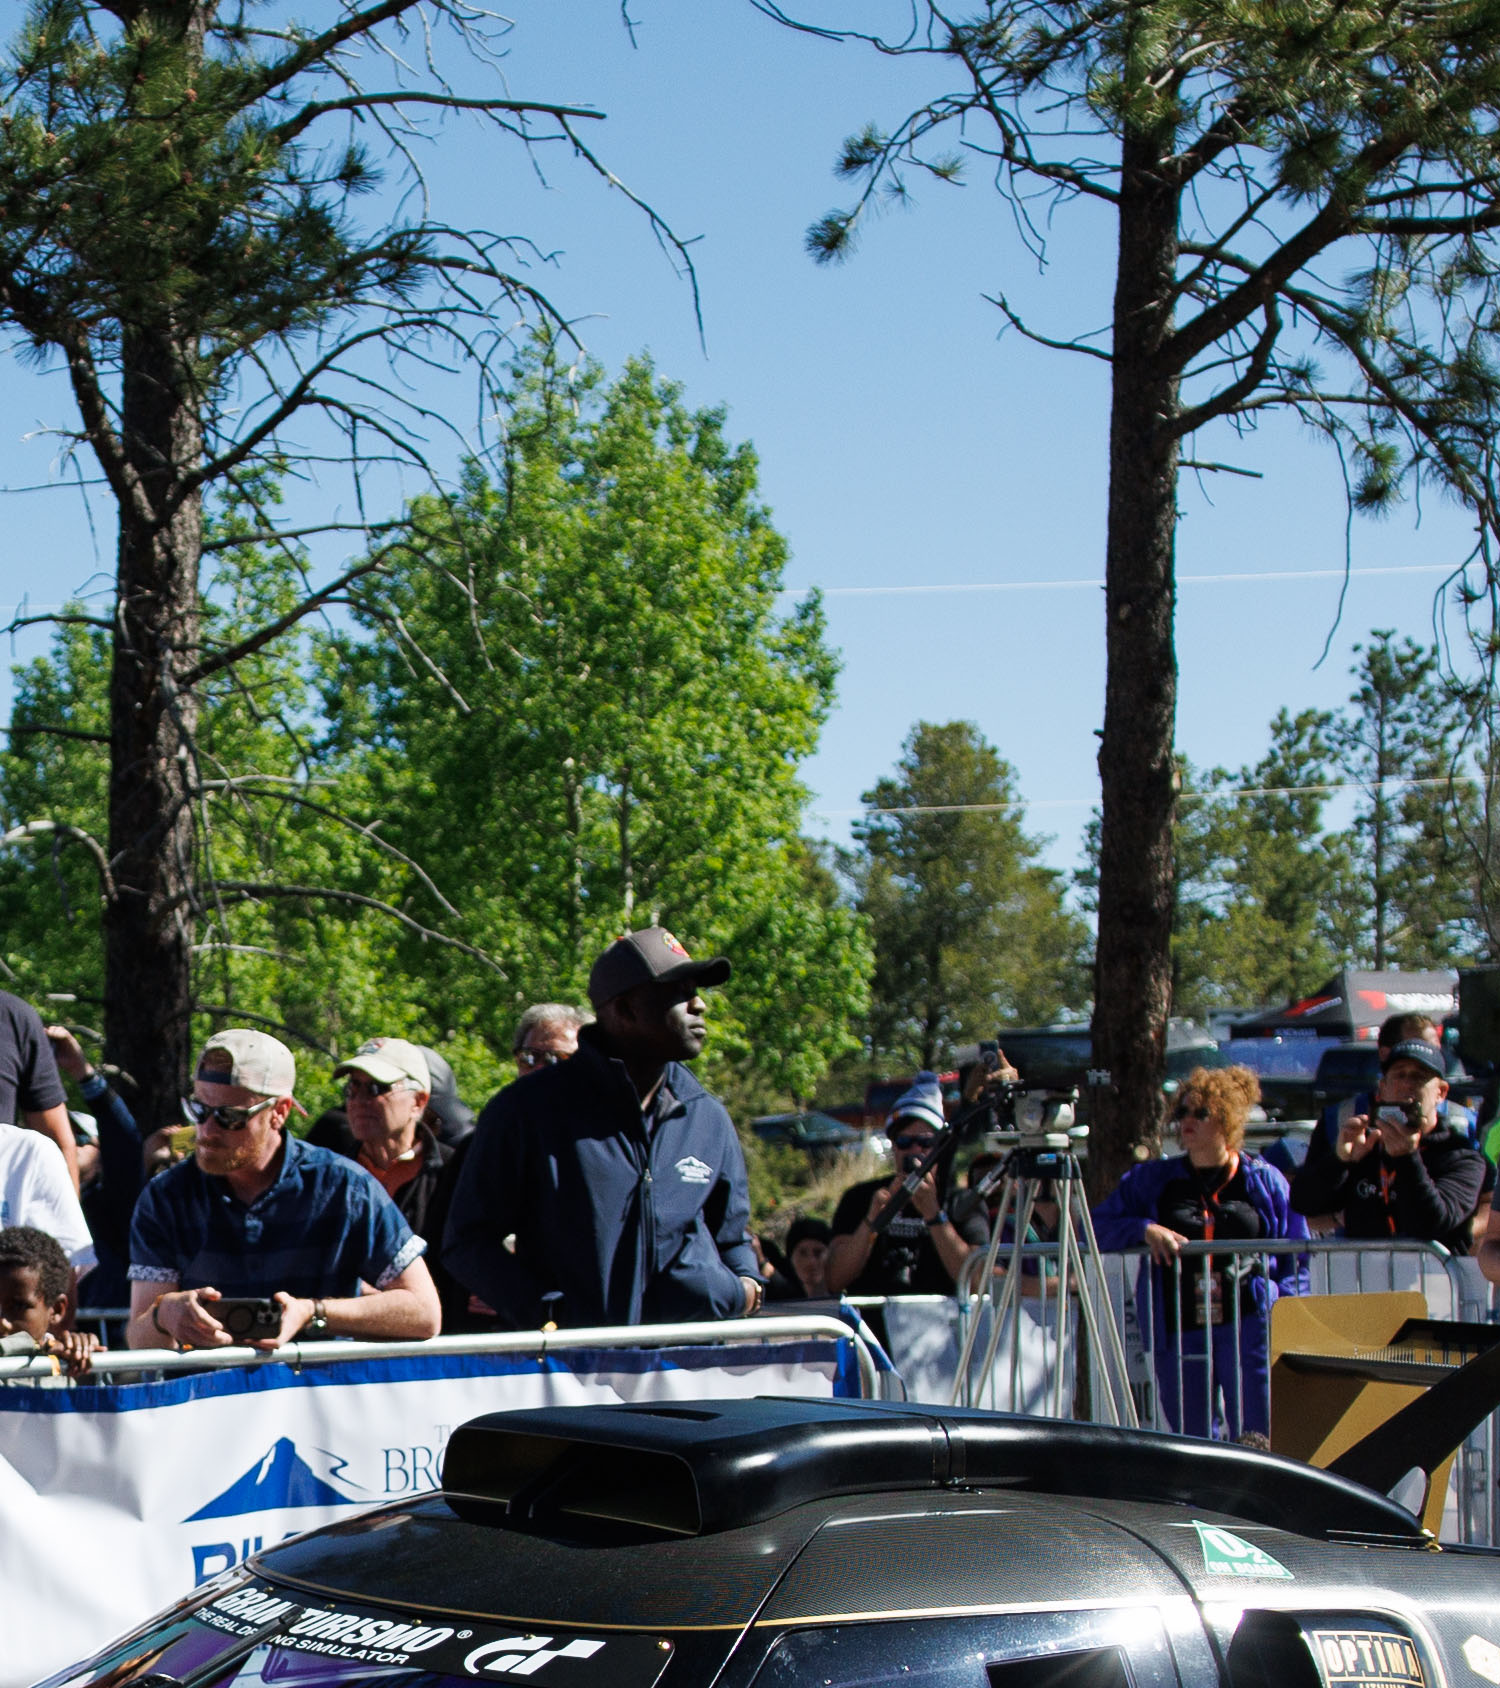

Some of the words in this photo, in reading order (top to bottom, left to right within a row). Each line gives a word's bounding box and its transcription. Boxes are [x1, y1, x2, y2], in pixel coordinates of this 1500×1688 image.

[1208, 1561, 1232, 1574] ON
[1233, 1562, 1288, 1577] BOARD
[212, 1587, 293, 1625] GRAN
[193, 1606, 217, 1621] THE
[209, 1615, 236, 1632] REAL
[295, 1639, 411, 1665] SIMULATOR
[1321, 1637, 1420, 1677] OPTIMA
